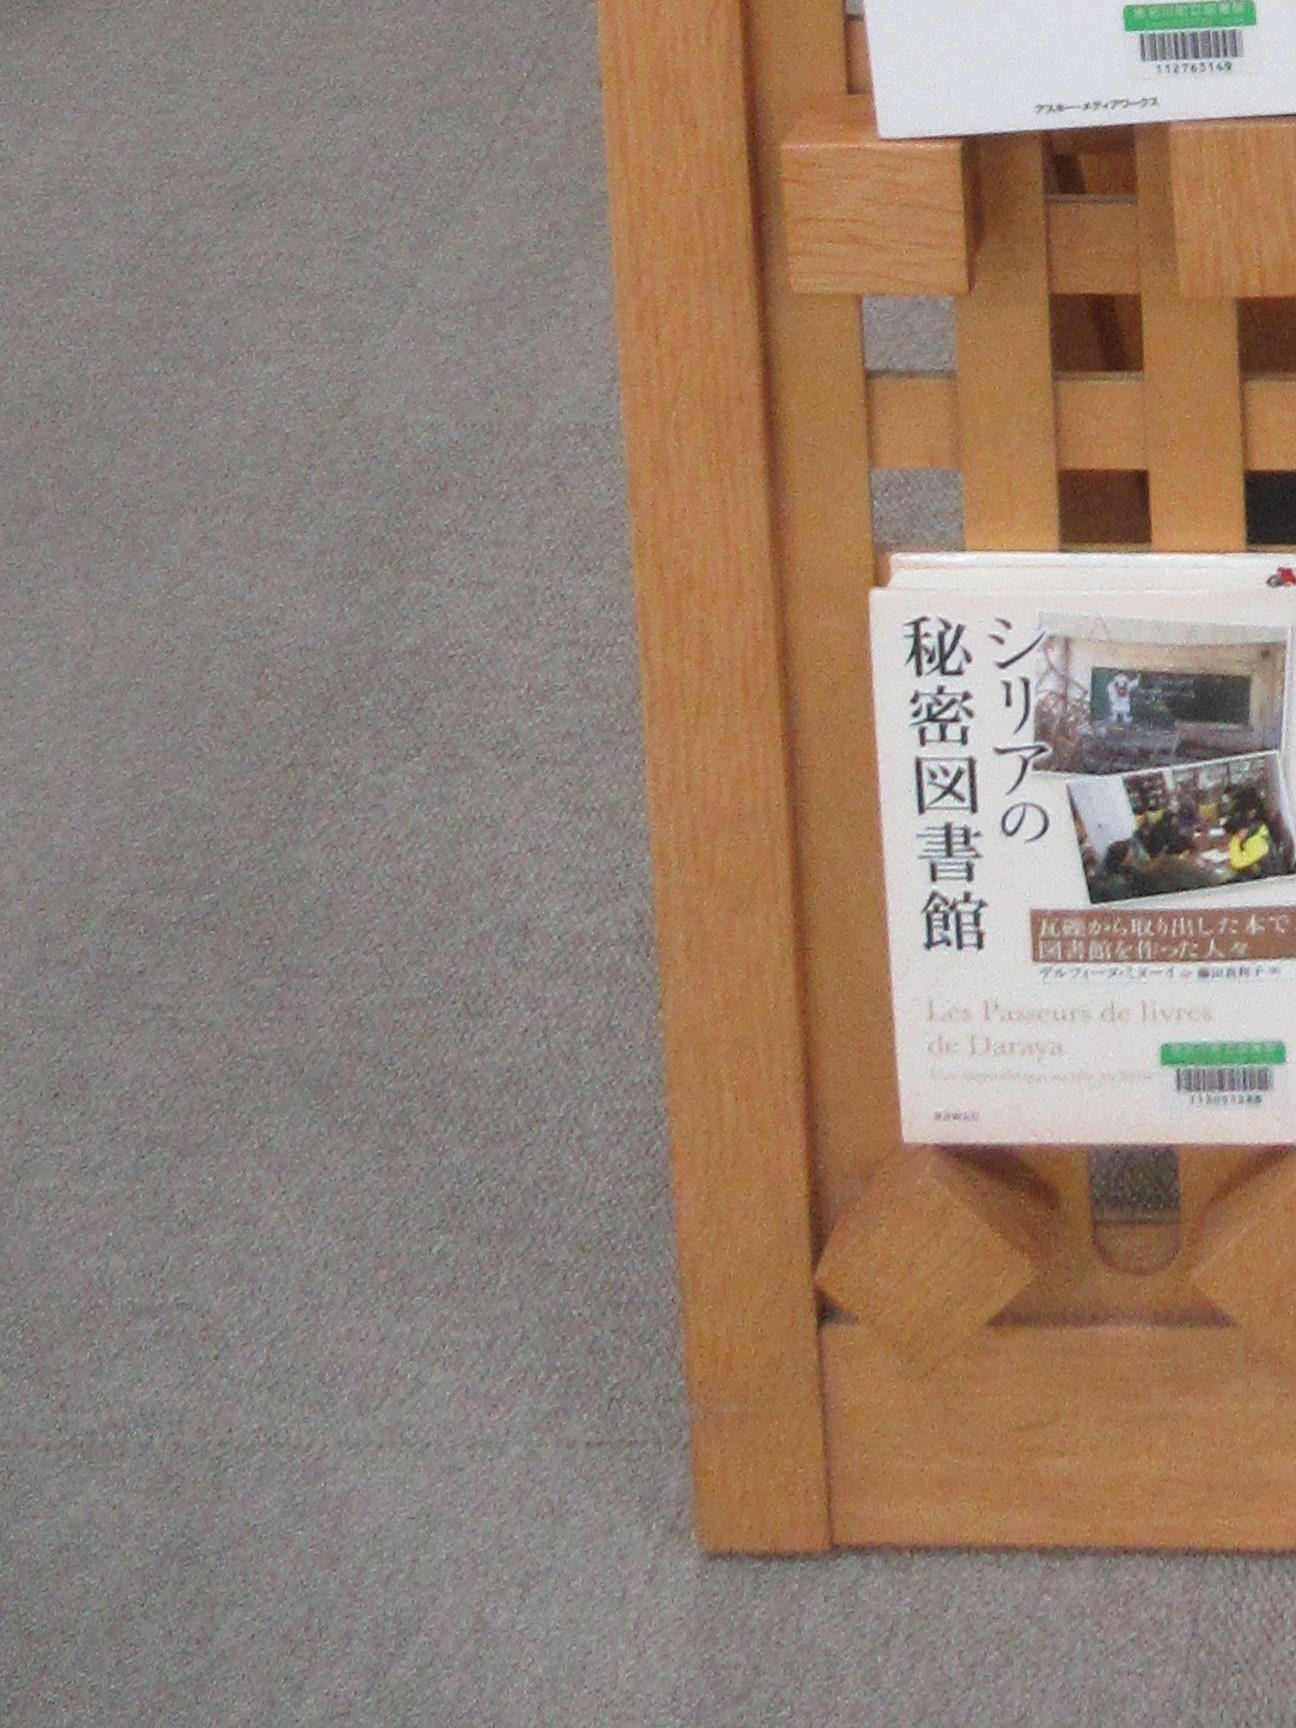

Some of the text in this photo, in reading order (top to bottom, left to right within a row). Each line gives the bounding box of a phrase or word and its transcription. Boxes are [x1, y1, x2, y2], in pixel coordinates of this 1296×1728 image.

[903, 615, 989, 953] 秘密図書館
[989, 616, 1051, 844] シリアの
